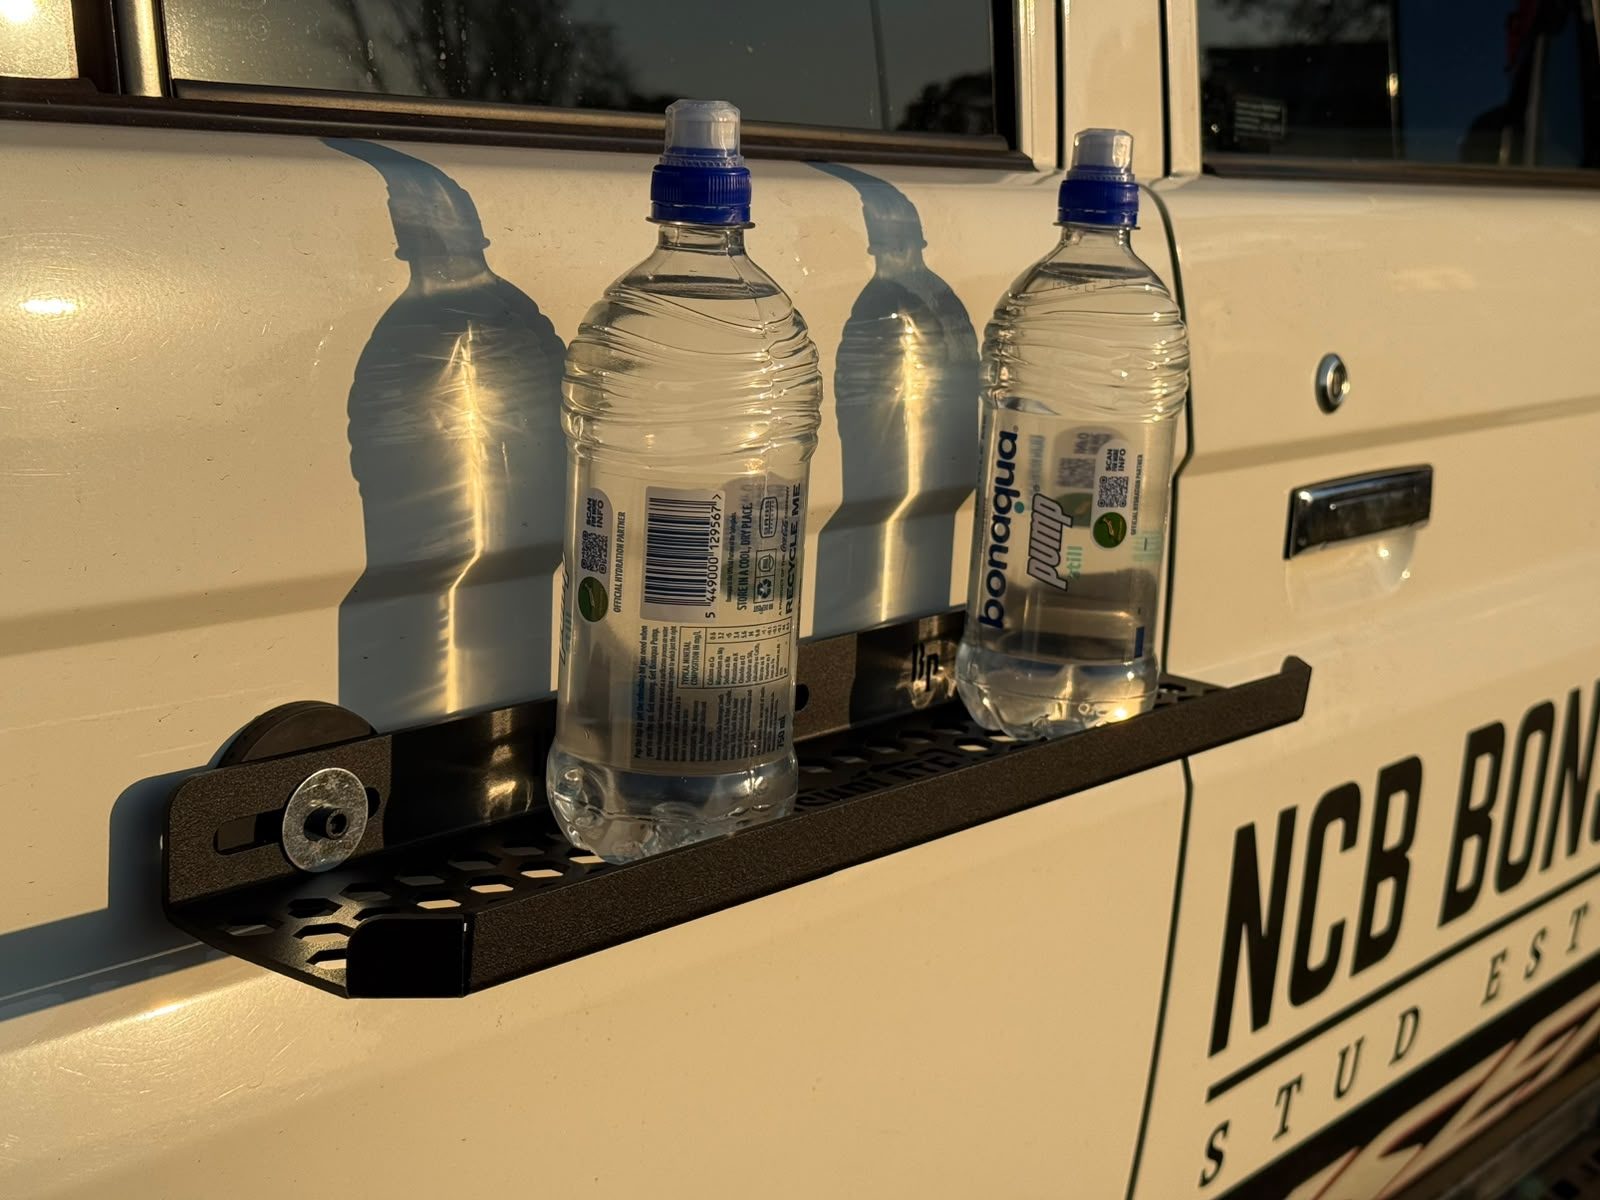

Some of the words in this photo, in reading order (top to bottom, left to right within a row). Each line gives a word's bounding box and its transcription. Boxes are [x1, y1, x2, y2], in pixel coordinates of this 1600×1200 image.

[1105, 449, 1113, 472] SCAN
[1118, 448, 1126, 472] INFO
[596, 499, 604, 529] INFO
[791, 483, 801, 516] ME
[616, 512, 626, 542] PARTNER
[710, 506, 721, 551] 129567
[741, 503, 753, 529] PLACE.
[977, 430, 1020, 629] bonaqua
[741, 529, 751, 546] DRY
[1026, 493, 1073, 592] pump
[614, 542, 625, 583] HYDRATION
[739, 546, 752, 569] COOL,
[785, 521, 798, 615] RECYCLE
[706, 557, 719, 602] 449000
[738, 576, 748, 585] IN
[612, 583, 623, 613] OFFICIAL
[737, 586, 748, 611] STORE
[691, 651, 700, 686] COMPOSITION
[1208, 755, 1423, 1058] NCB
[1438, 679, 1600, 928] BON
[1199, 1006, 1420, 1188] STUD
